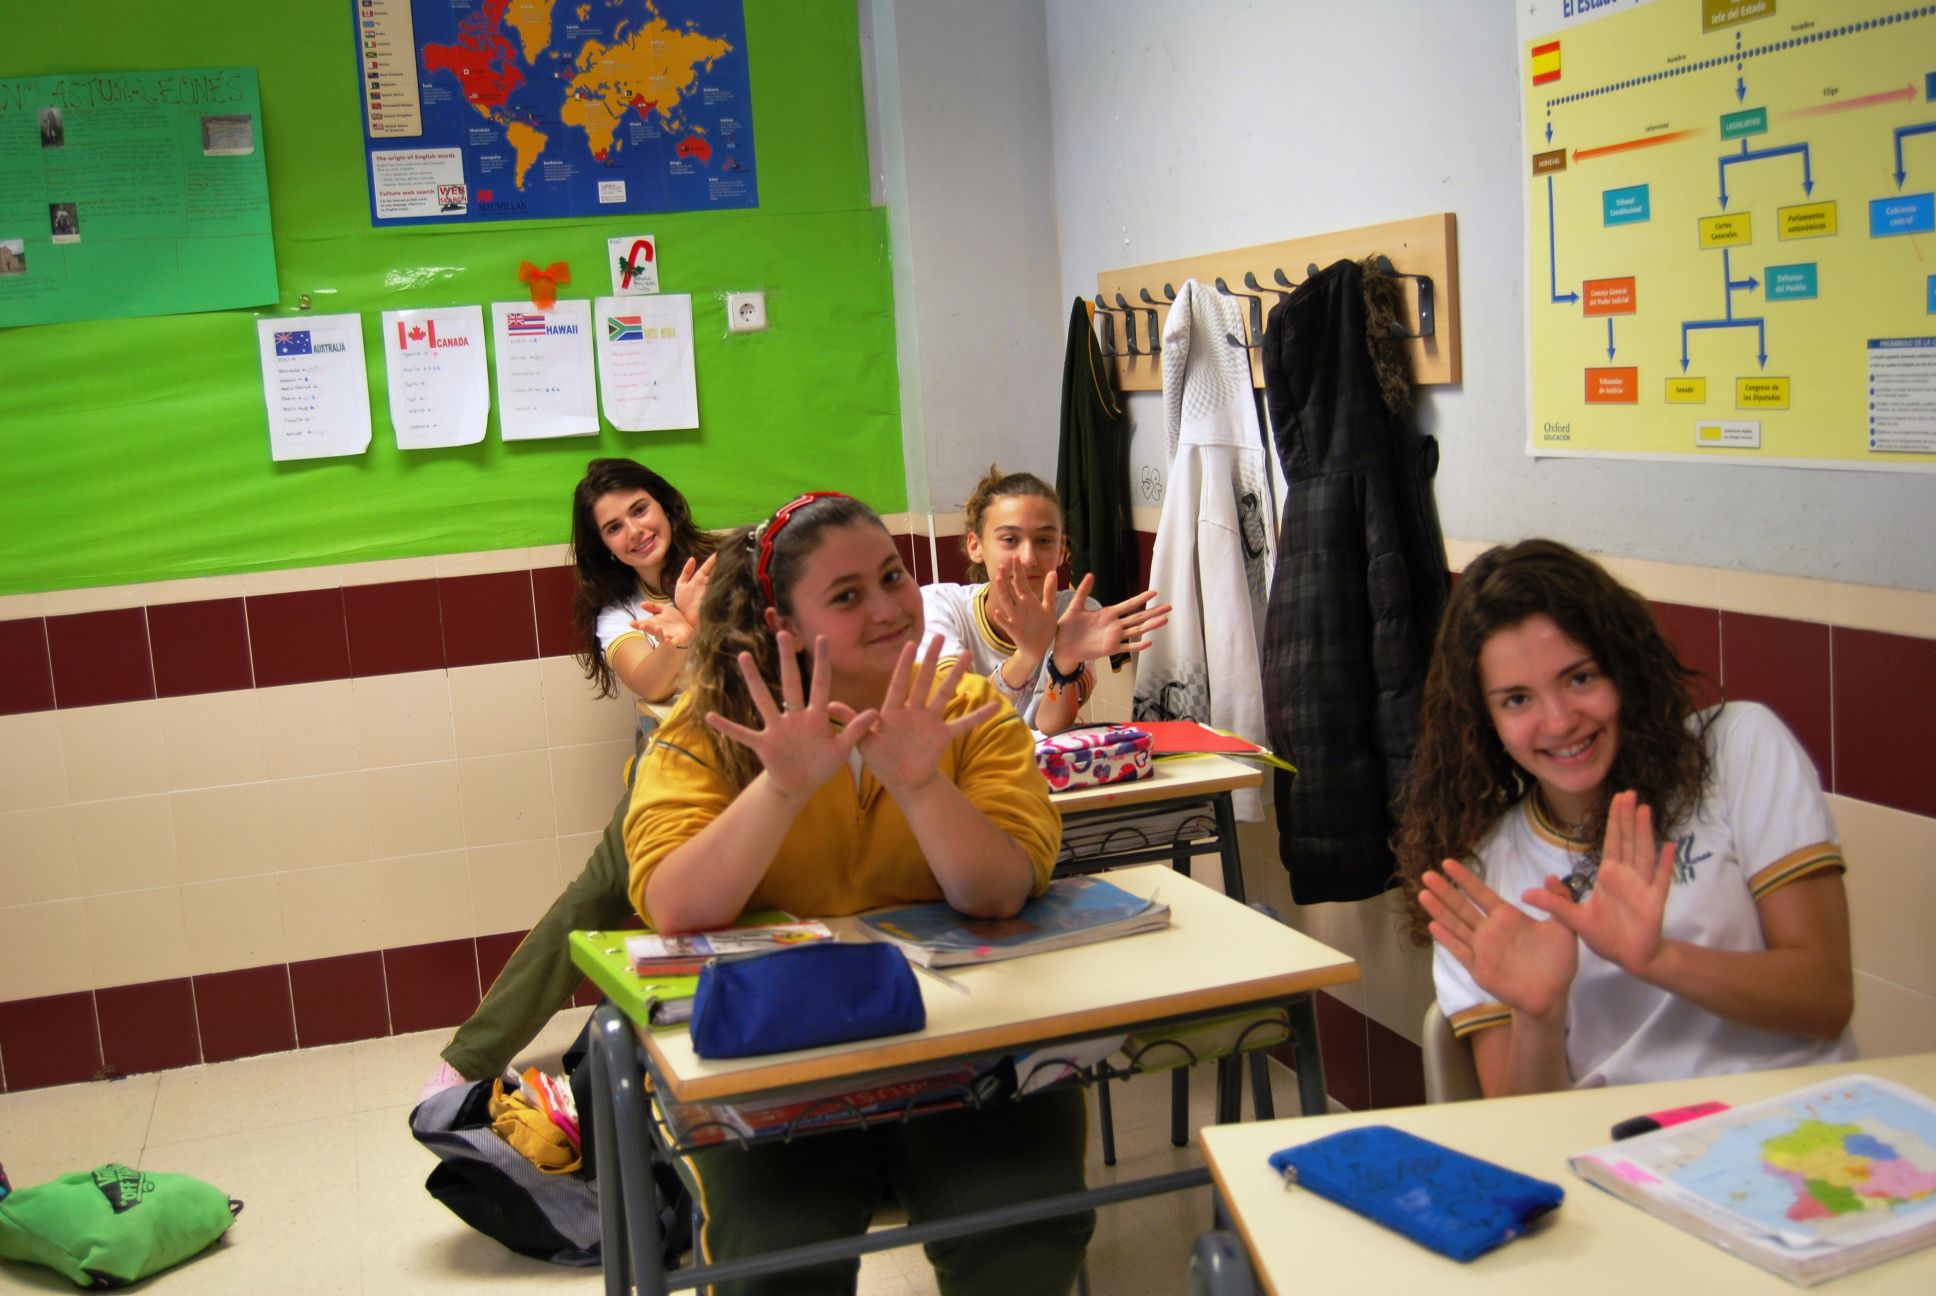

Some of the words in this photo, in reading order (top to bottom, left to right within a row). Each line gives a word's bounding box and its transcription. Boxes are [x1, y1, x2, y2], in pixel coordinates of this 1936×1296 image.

[1711, 11, 1725, 25] Jefe
[1727, 8, 1739, 19] del
[1741, 2, 1766, 16] Estado
[1823, 87, 1839, 96] Elige
[1726, 118, 1760, 131] LEGISLATIVO
[415, 153, 436, 161] English
[1539, 158, 1560, 168] JUDICIAL
[440, 186, 465, 196] WEB
[1616, 197, 1635, 206] Tribunal
[1610, 206, 1642, 217] Constitucional
[1885, 204, 1917, 216] Gobierno
[1788, 212, 1825, 223] Parlamentos
[1889, 216, 1914, 226] central
[1715, 222, 1732, 231] Cortes
[1788, 222, 1826, 234] autonómicos
[1711, 232, 1738, 241] Generales
[1777, 274, 1804, 285] Defensor
[1590, 289, 1608, 297] Consejo
[1609, 287, 1628, 296] General
[1775, 284, 1785, 293] del
[1786, 282, 1807, 293] Pueblo
[1589, 298, 1597, 306] del
[1598, 297, 1611, 305] Poder
[1611, 295, 1630, 304] Judicial
[546, 324, 579, 335] HAWAII
[436, 337, 470, 348] CANADA
[313, 342, 346, 355] AUSTRALIA
[1599, 378, 1623, 386] Tribunales
[1676, 385, 1694, 393] Senado
[1745, 383, 1770, 394] Congreso
[1772, 382, 1779, 391] de
[1753, 391, 1781, 403] Diputados
[1544, 421, 1570, 433] Oxford
[1544, 433, 1571, 441] EDUCACIÓN
